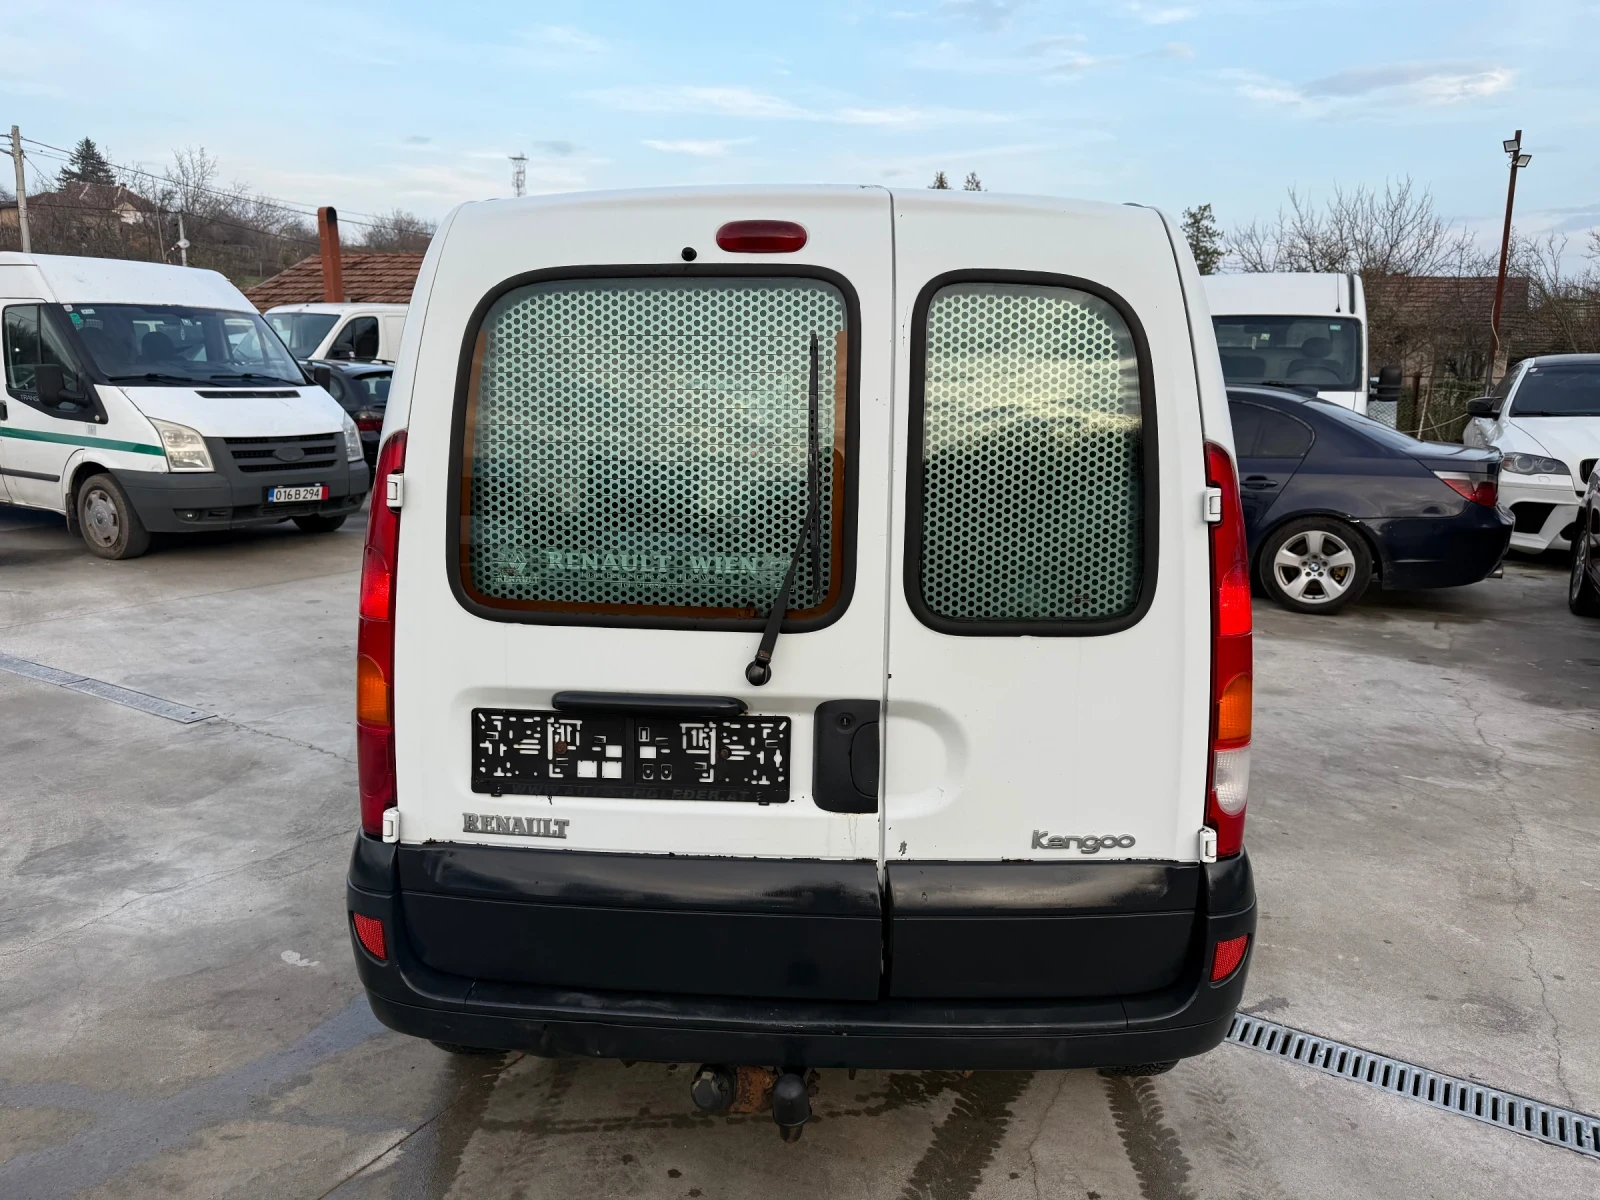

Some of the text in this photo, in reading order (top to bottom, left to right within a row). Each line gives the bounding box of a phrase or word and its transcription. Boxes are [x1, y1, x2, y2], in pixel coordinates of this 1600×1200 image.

[20, 394, 40, 402] TRANS
[548, 551, 758, 575] RENAULT WIEN
[462, 812, 569, 839] RENAULT
[1031, 829, 1136, 854] Kangoo
